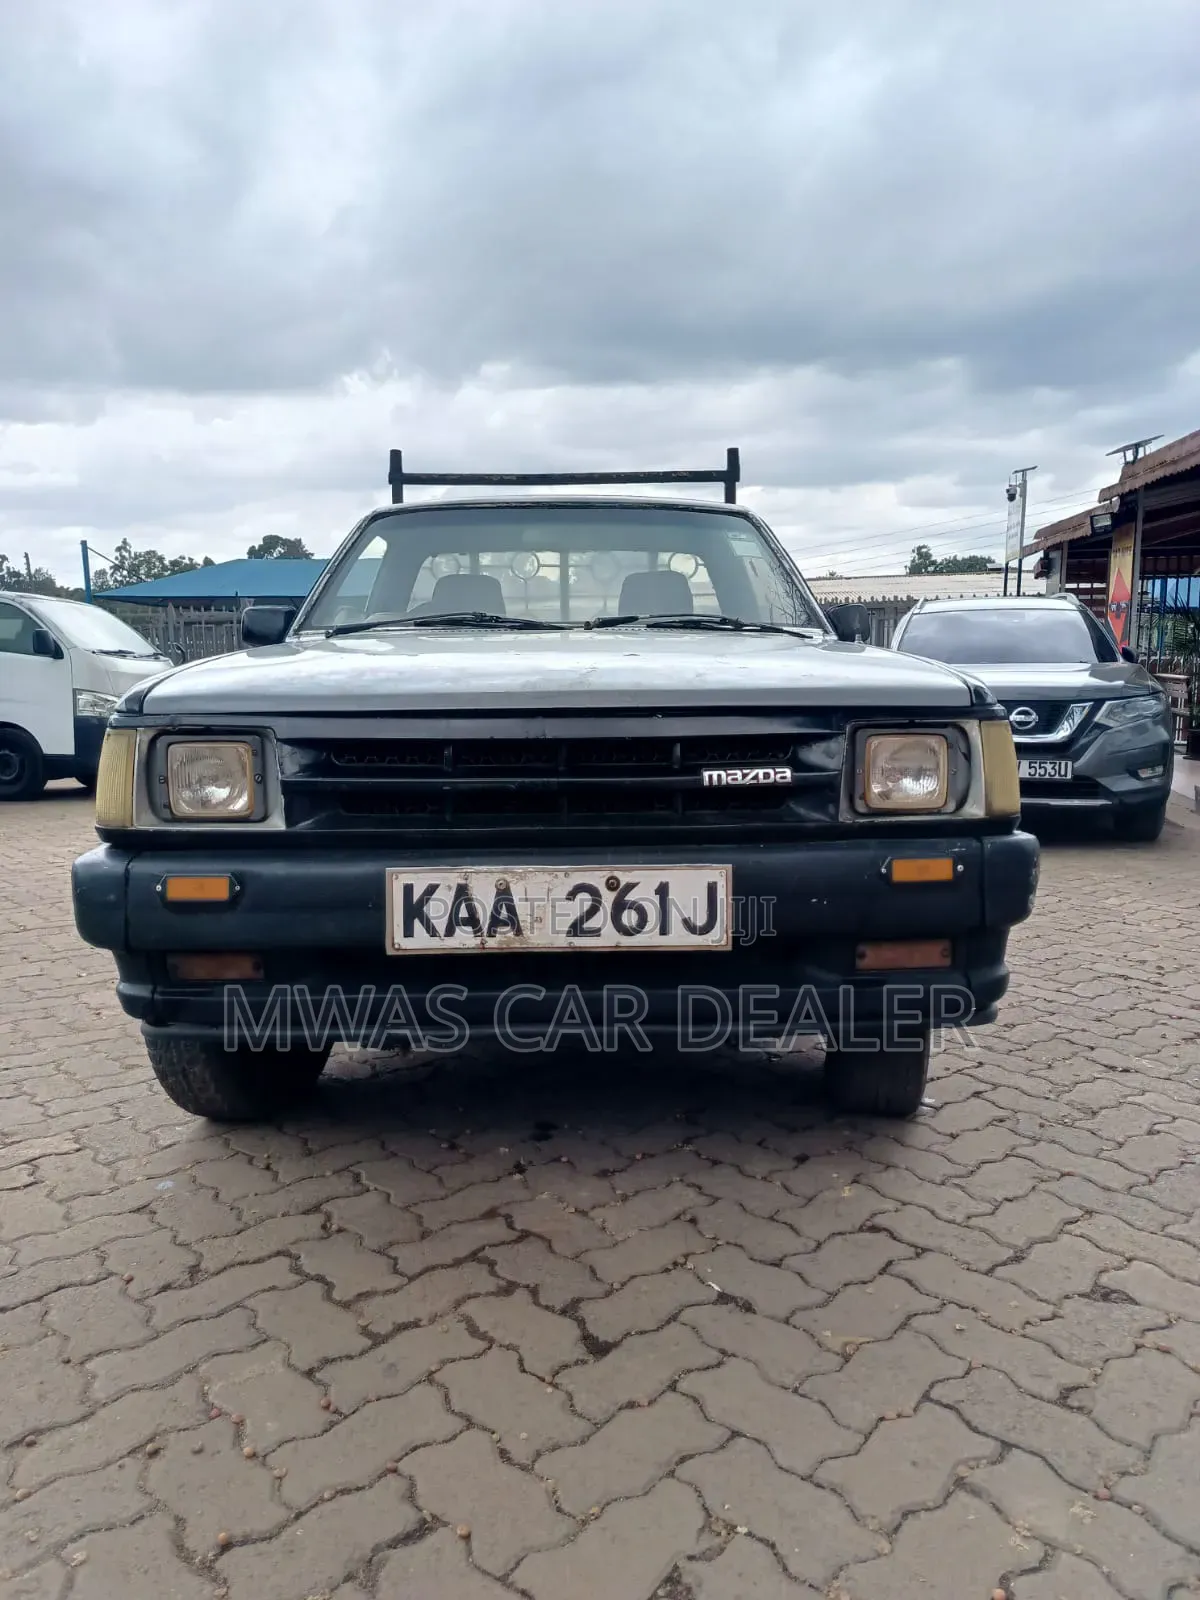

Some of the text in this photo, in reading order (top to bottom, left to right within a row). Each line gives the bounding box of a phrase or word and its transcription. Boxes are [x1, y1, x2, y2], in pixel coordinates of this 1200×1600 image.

[702, 767, 792, 786] mazda
[403, 880, 718, 938] KAA 261J
